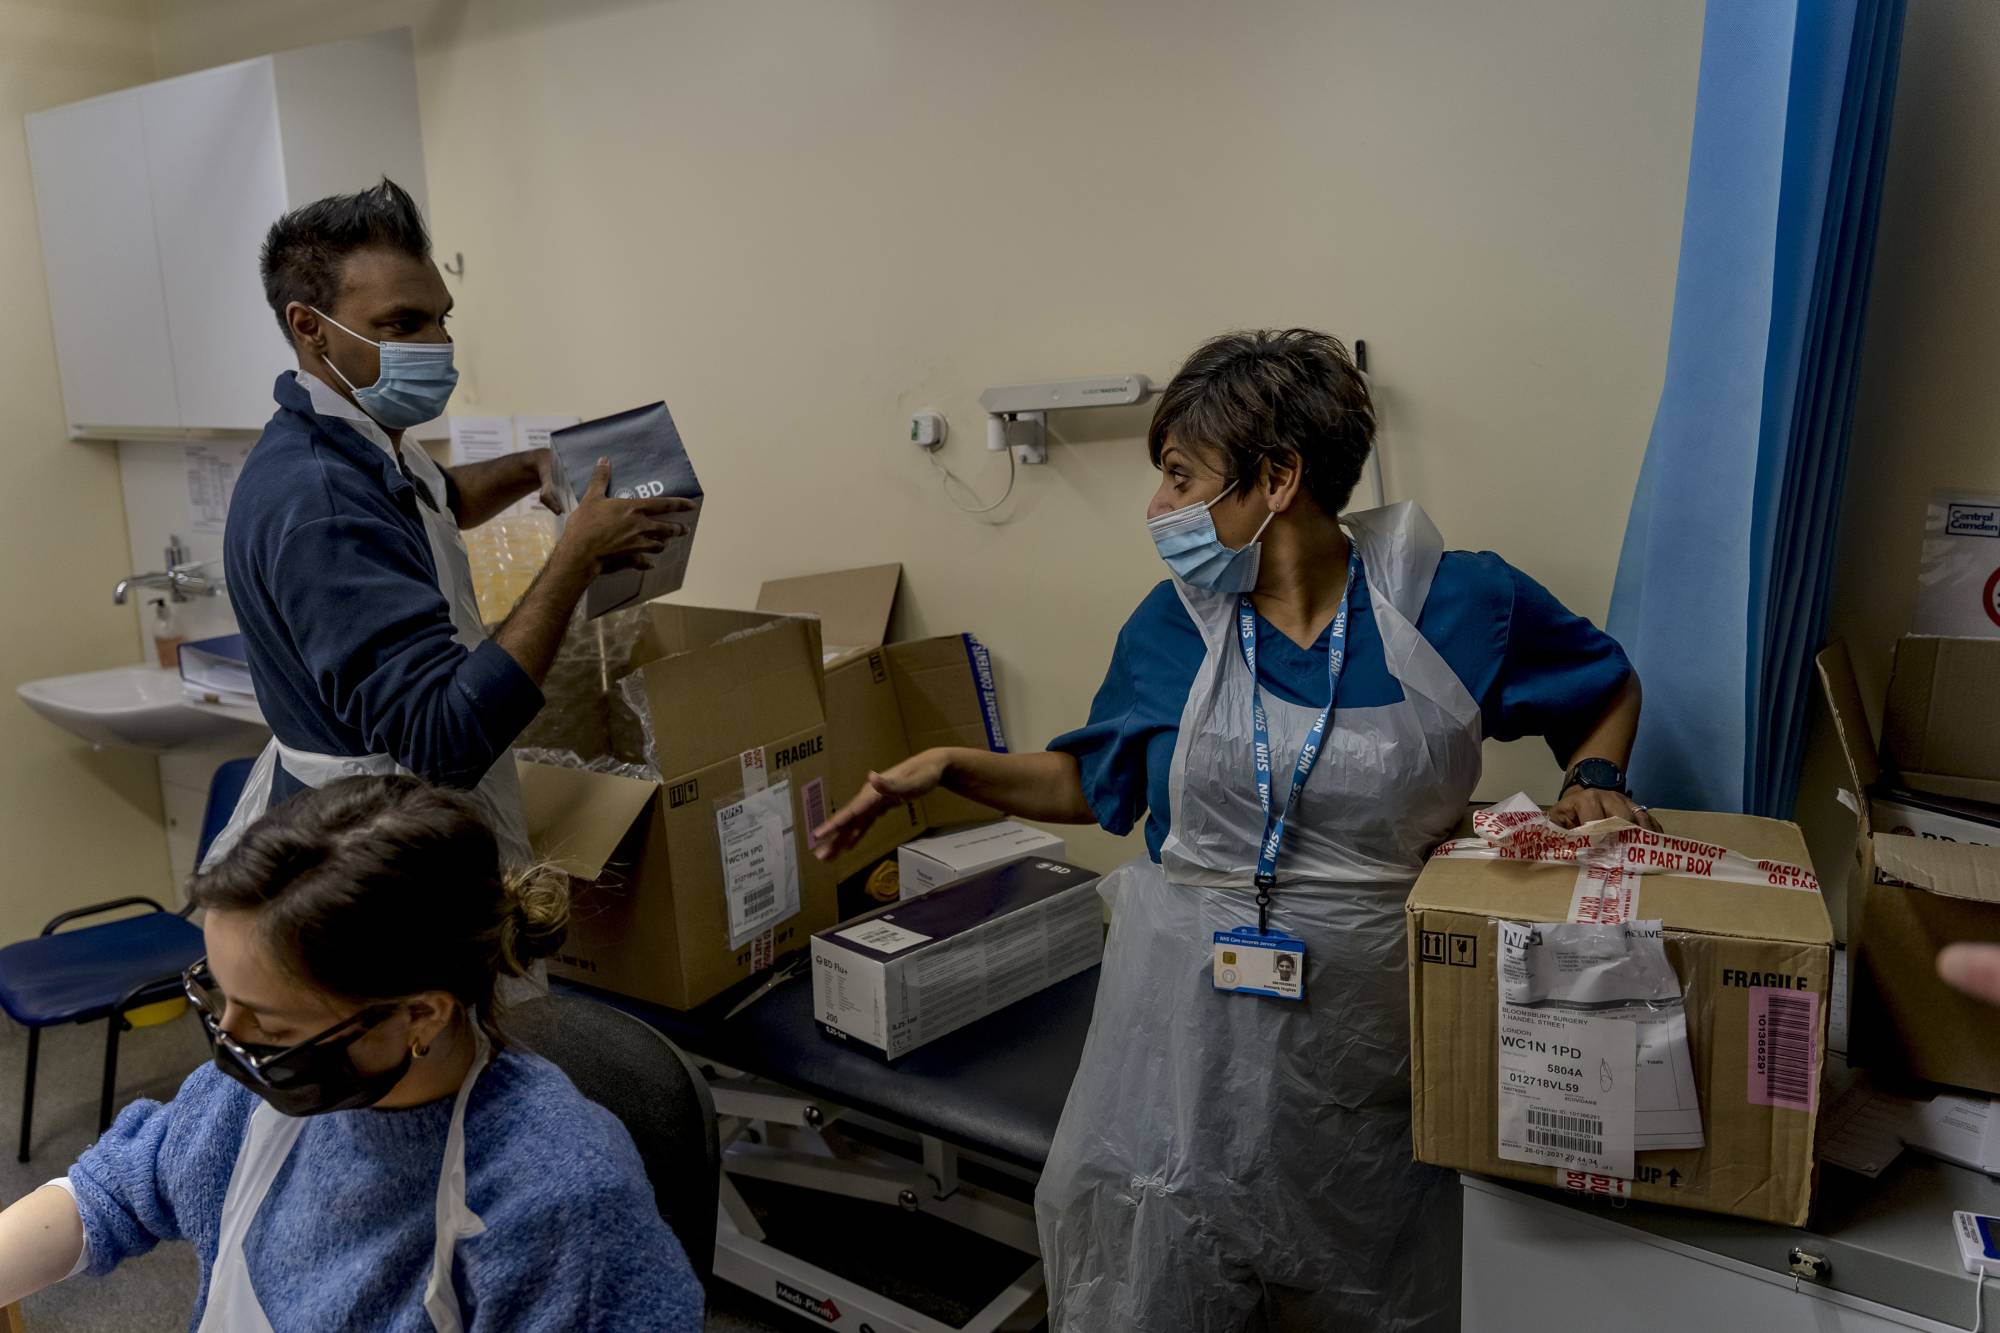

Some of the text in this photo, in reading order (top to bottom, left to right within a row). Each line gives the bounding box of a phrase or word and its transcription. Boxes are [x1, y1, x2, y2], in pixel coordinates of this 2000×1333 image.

[635, 481, 664, 499] BD
[1951, 520, 1998, 530] Camden
[1952, 510, 1994, 521] Central
[1242, 615, 1254, 639] NHS
[1333, 612, 1346, 638] NHS
[1330, 649, 1343, 677] NHS
[1255, 705, 1266, 733] NHS
[775, 735, 824, 769] FRAGILE
[1256, 742, 1269, 772] NHS
[1297, 743, 1316, 775] NHS
[720, 805, 743, 821] NHS
[1263, 831, 1280, 863] NHS
[1619, 828, 1727, 860] MIXED PRODUCT
[1049, 865, 1071, 875] BD
[1628, 846, 1713, 877] OR PART BOX
[1769, 874, 1788, 887] OR
[1792, 876, 1818, 890] PAR
[823, 958, 833, 969] BD
[1723, 968, 1808, 991] FRAGILE
[826, 1011, 838, 1024] 200
[1502, 1007, 1551, 1021] BLOOMSBURY
[1553, 1014, 1588, 1026] SURGERY
[1507, 1015, 1536, 1025] HANDEL
[1538, 1019, 1565, 1030] STREET
[1502, 1027, 1532, 1037] LONDON
[1501, 1035, 1581, 1059] WC1N 1PD
[1757, 1014, 1766, 1075] 101366291
[1547, 1063, 1583, 1078] 5804A
[1509, 1072, 1579, 1093] 012718VL59
[1530, 1104, 1558, 1114] Container
[1637, 1166, 1662, 1184] UP
